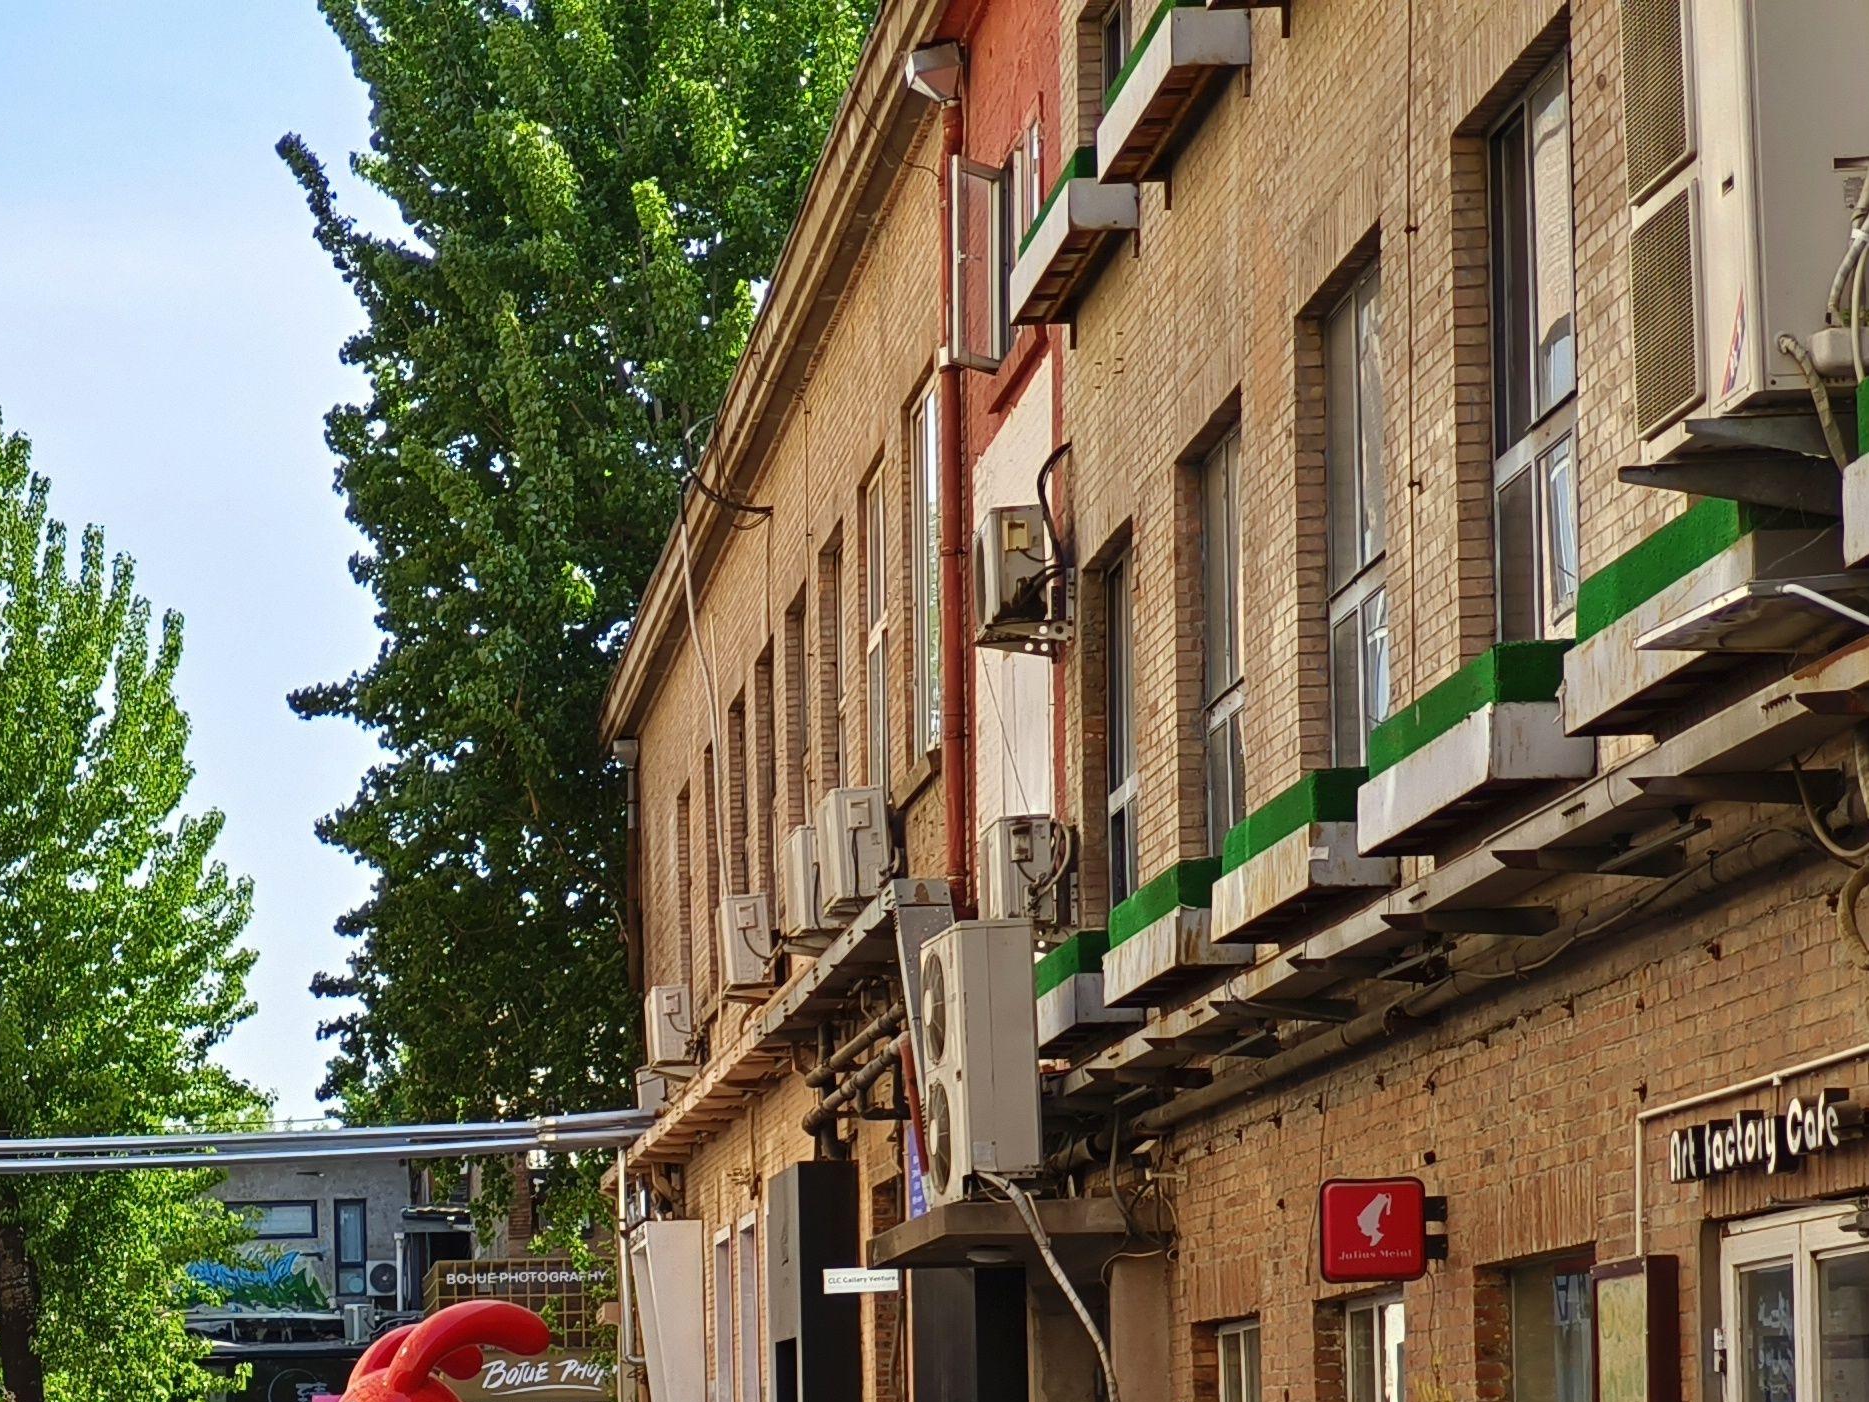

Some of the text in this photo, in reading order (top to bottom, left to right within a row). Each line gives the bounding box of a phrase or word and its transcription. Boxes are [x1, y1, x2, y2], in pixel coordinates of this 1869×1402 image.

[1670, 1130, 1697, 1183] Art
[1339, 1249, 1412, 1261] Julius Meinl
[446, 1272, 497, 1285] BOJUE
[843, 1276, 867, 1284] Gallery
